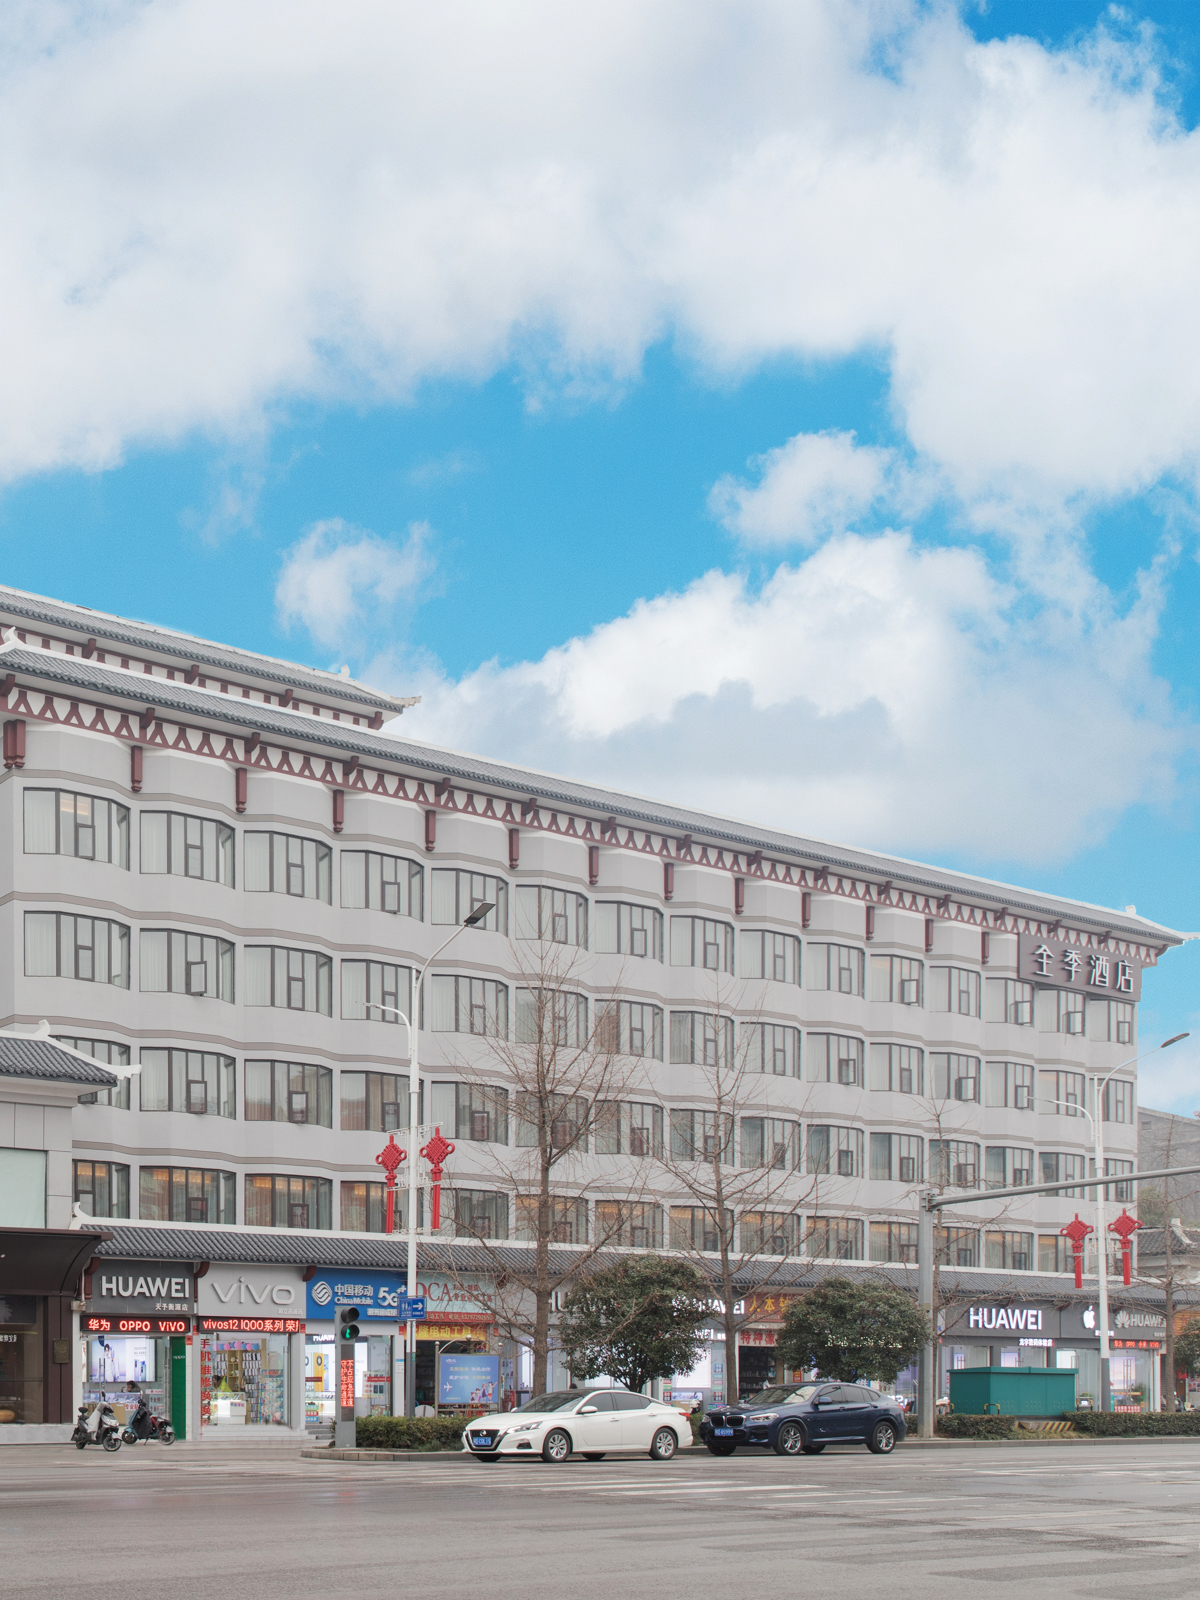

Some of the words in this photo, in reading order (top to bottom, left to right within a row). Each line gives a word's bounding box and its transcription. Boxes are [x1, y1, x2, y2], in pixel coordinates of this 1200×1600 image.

[1034, 944, 1134, 993] 全季酒店
[101, 1275, 190, 1298] HUAWEI
[211, 1276, 295, 1305] vivo
[334, 1284, 374, 1297] 中国移动
[334, 1296, 352, 1304] China
[353, 1297, 374, 1305] Mobile
[88, 1318, 111, 1331] 华为
[969, 1307, 1043, 1330] HUAWEI
[119, 1320, 151, 1331] OPPO
[414, 1325, 471, 1338] 隆电动工具
